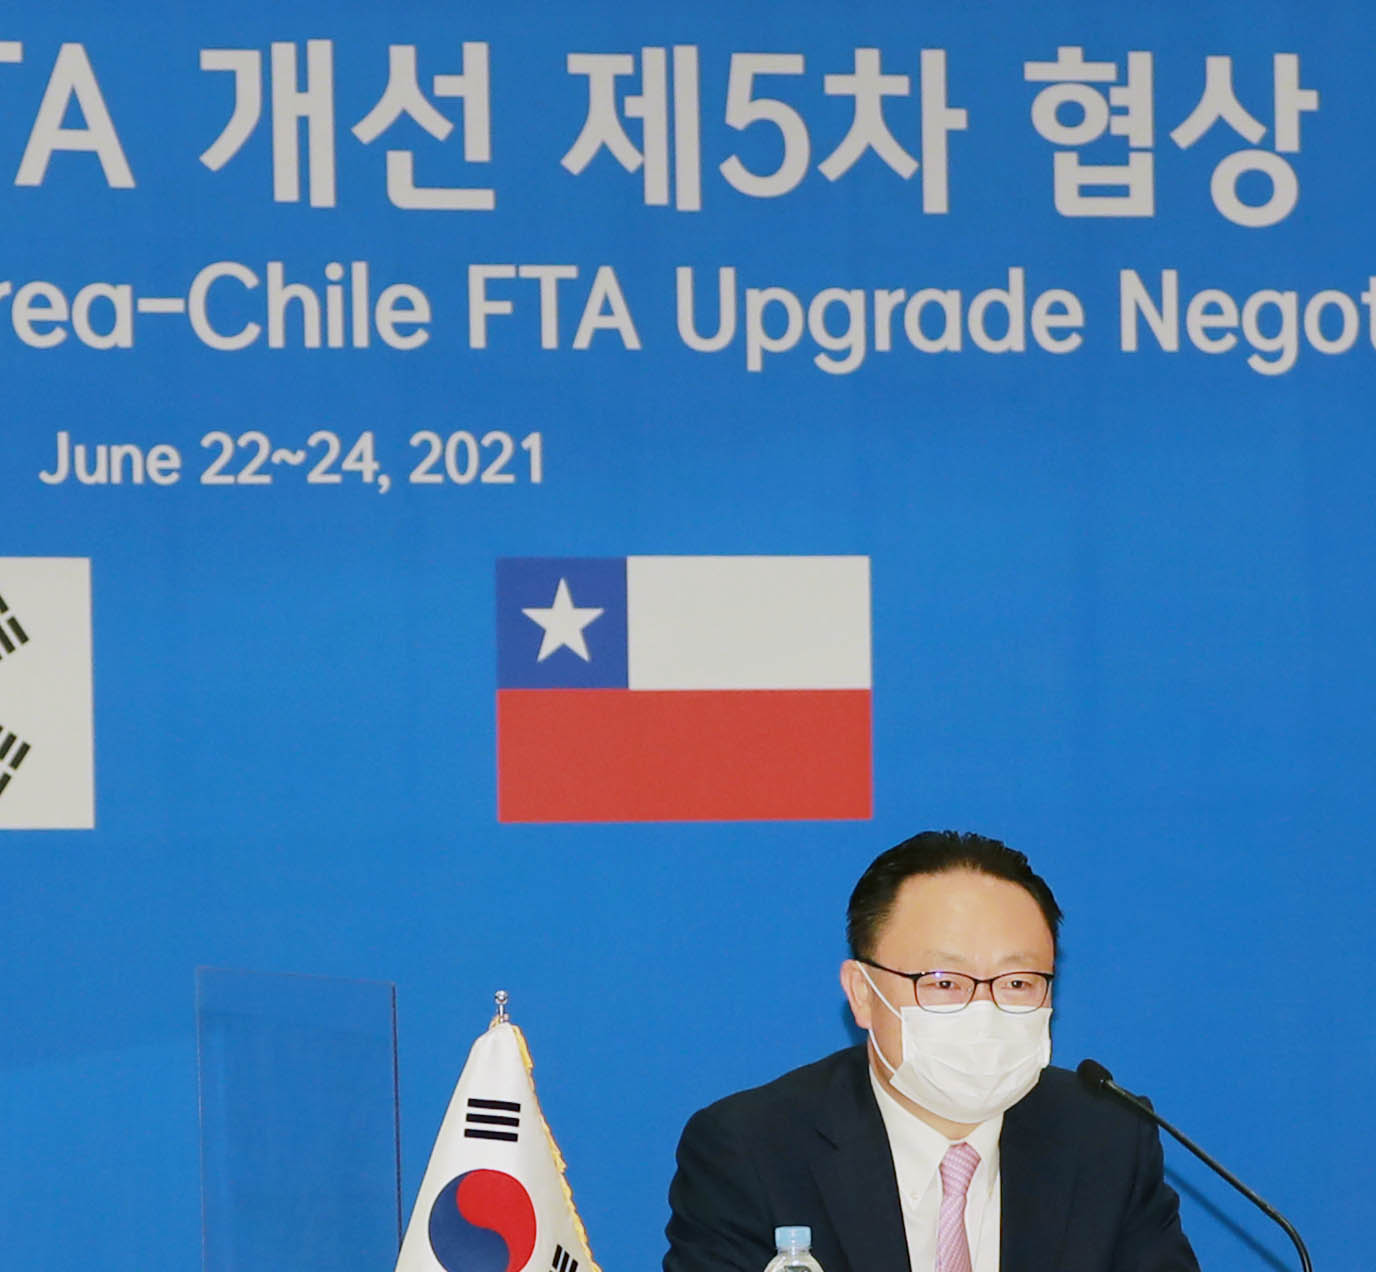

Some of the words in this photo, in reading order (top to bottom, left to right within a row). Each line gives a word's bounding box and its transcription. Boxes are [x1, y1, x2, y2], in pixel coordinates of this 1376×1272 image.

[200, 40, 495, 210] 개선
[561, 45, 967, 214] 제5차
[1024, 47, 1318, 227] 협상
[469, 265, 641, 349] FTA
[677, 267, 1084, 374] Upgrade
[39, 432, 181, 485] June
[201, 431, 390, 493] 22~24,
[410, 431, 542, 484] 2021
